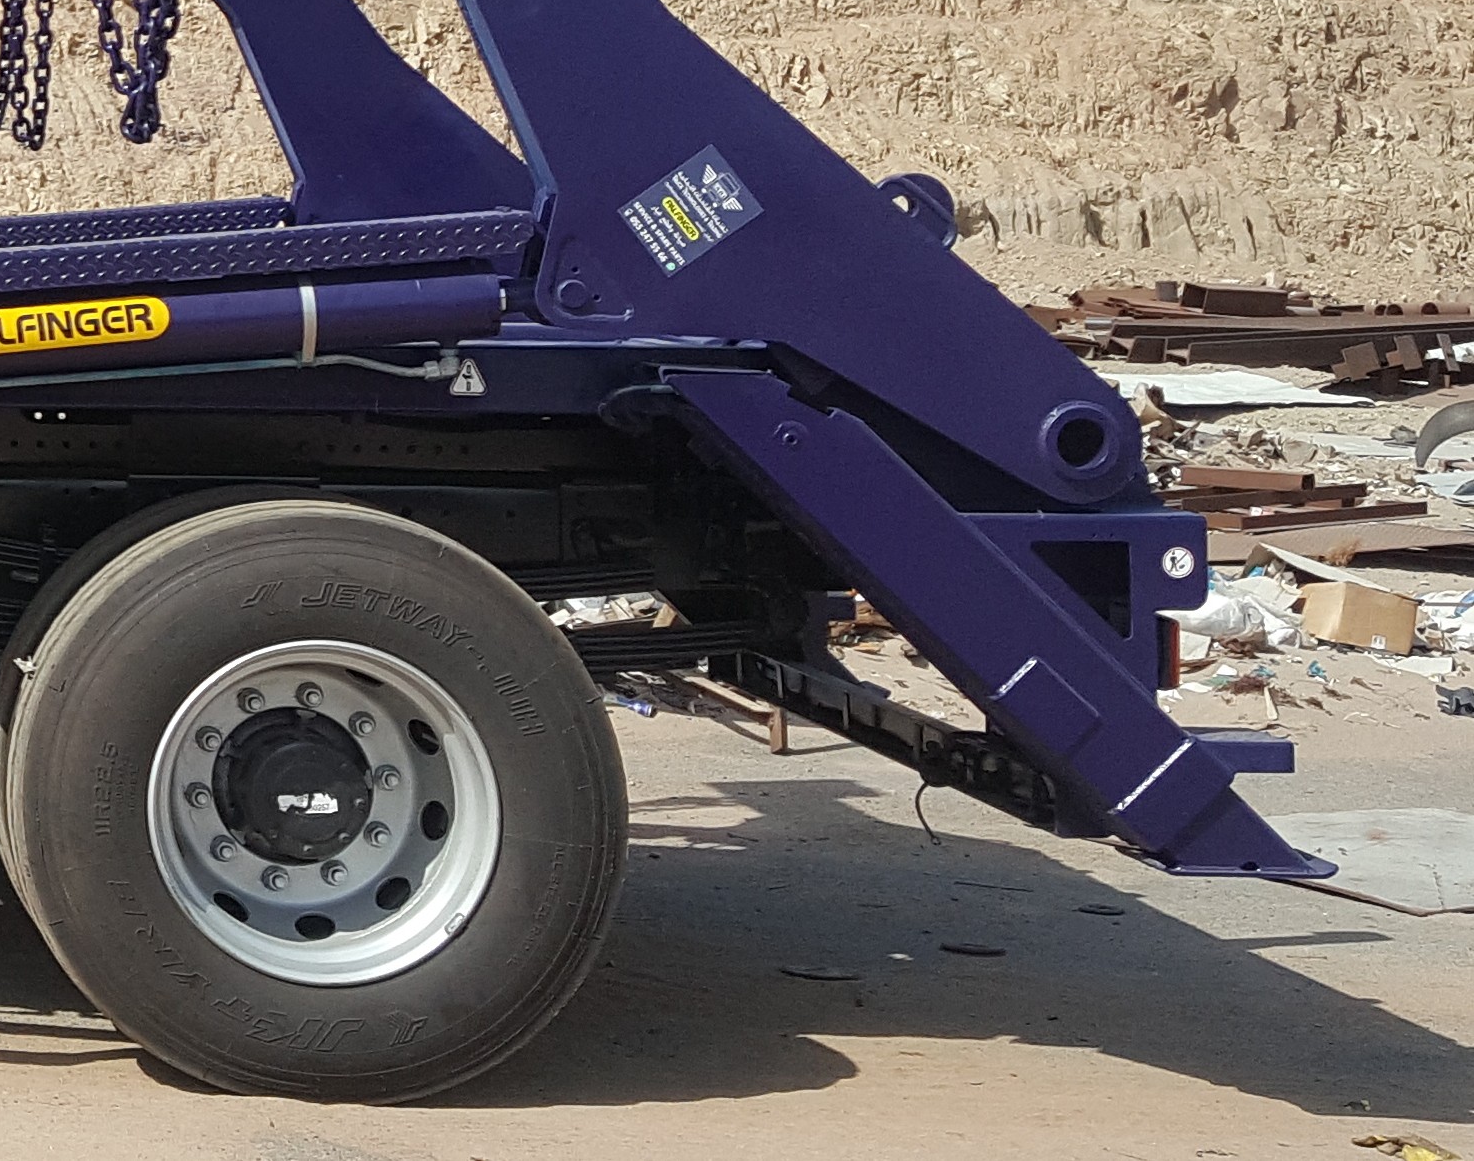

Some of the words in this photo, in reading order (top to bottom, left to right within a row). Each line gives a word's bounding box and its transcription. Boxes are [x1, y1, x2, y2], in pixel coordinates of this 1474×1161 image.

[634, 202, 653, 224] SERVICE
[655, 229, 671, 247] SPARE
[669, 247, 685, 265] PARTS
[640, 229, 653, 243] 247
[666, 200, 696, 237] PALFINGER
